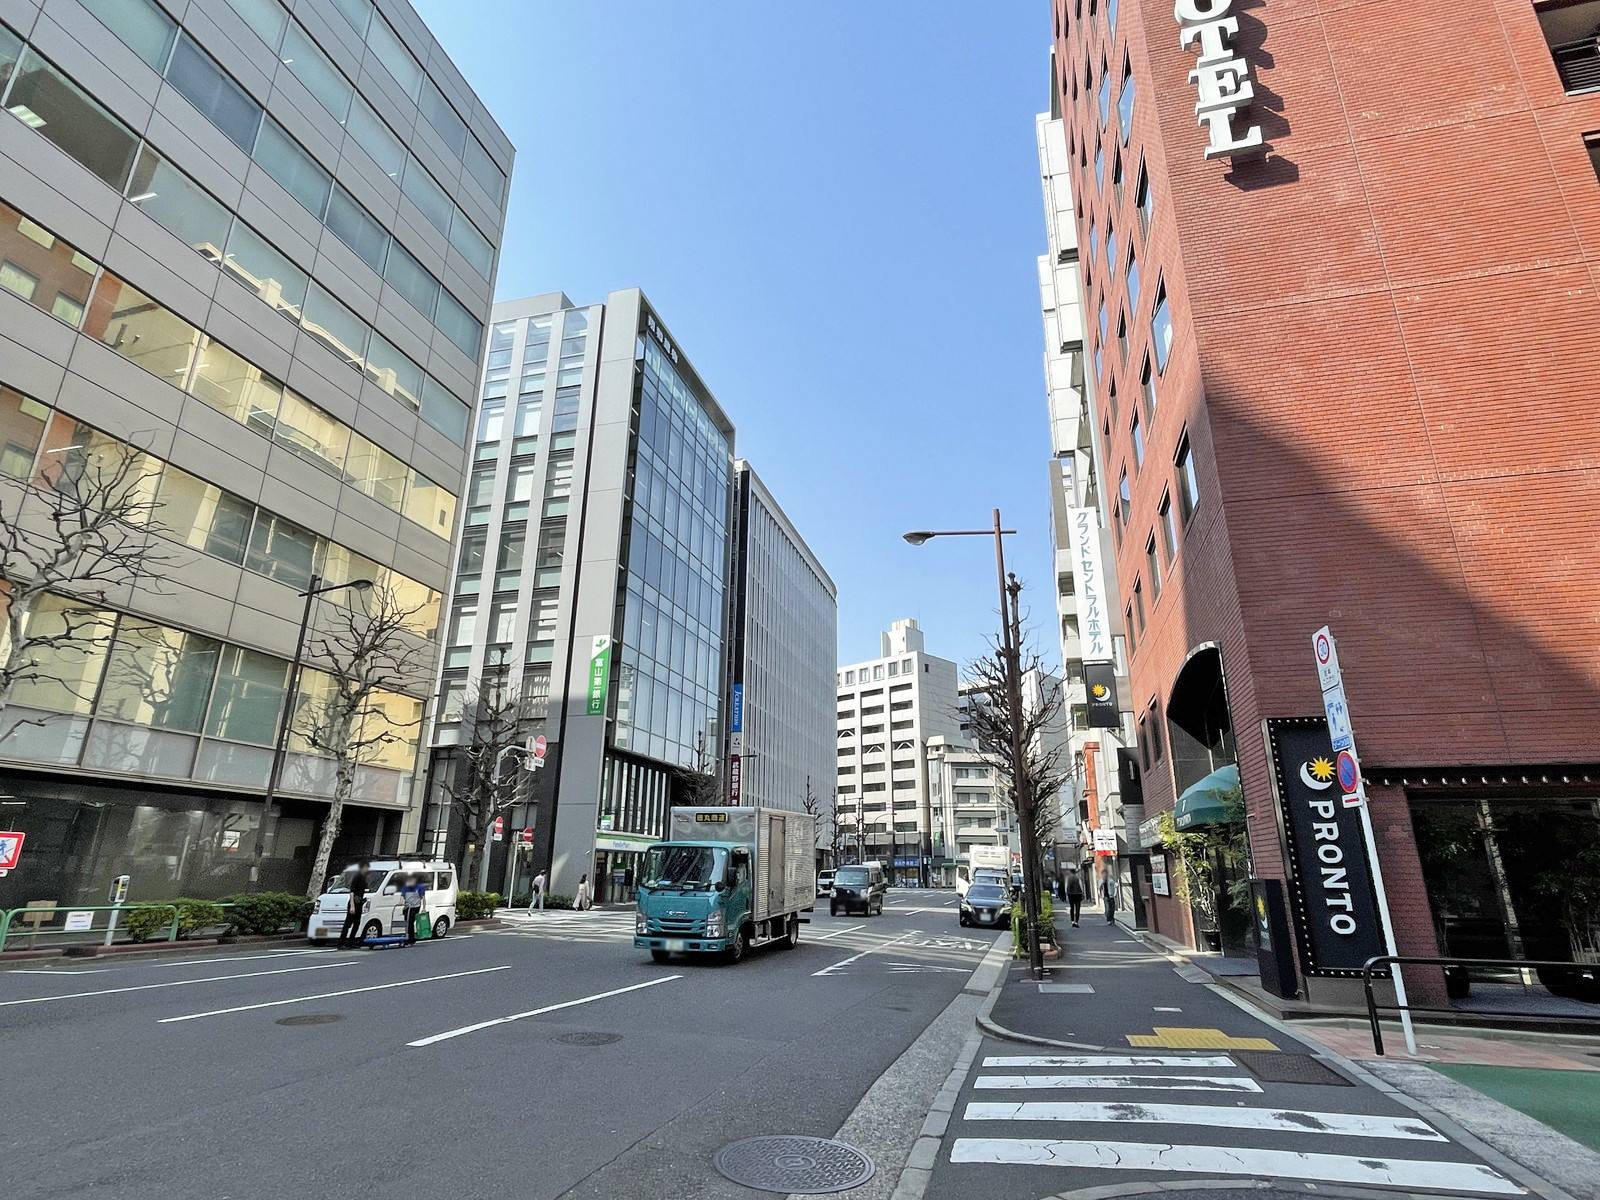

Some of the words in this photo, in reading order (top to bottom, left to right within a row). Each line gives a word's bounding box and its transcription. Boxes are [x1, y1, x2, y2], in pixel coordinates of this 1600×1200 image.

[1076, 511, 1104, 655] グランドセントラルホテル
[1308, 799, 1357, 936] PRONTO
